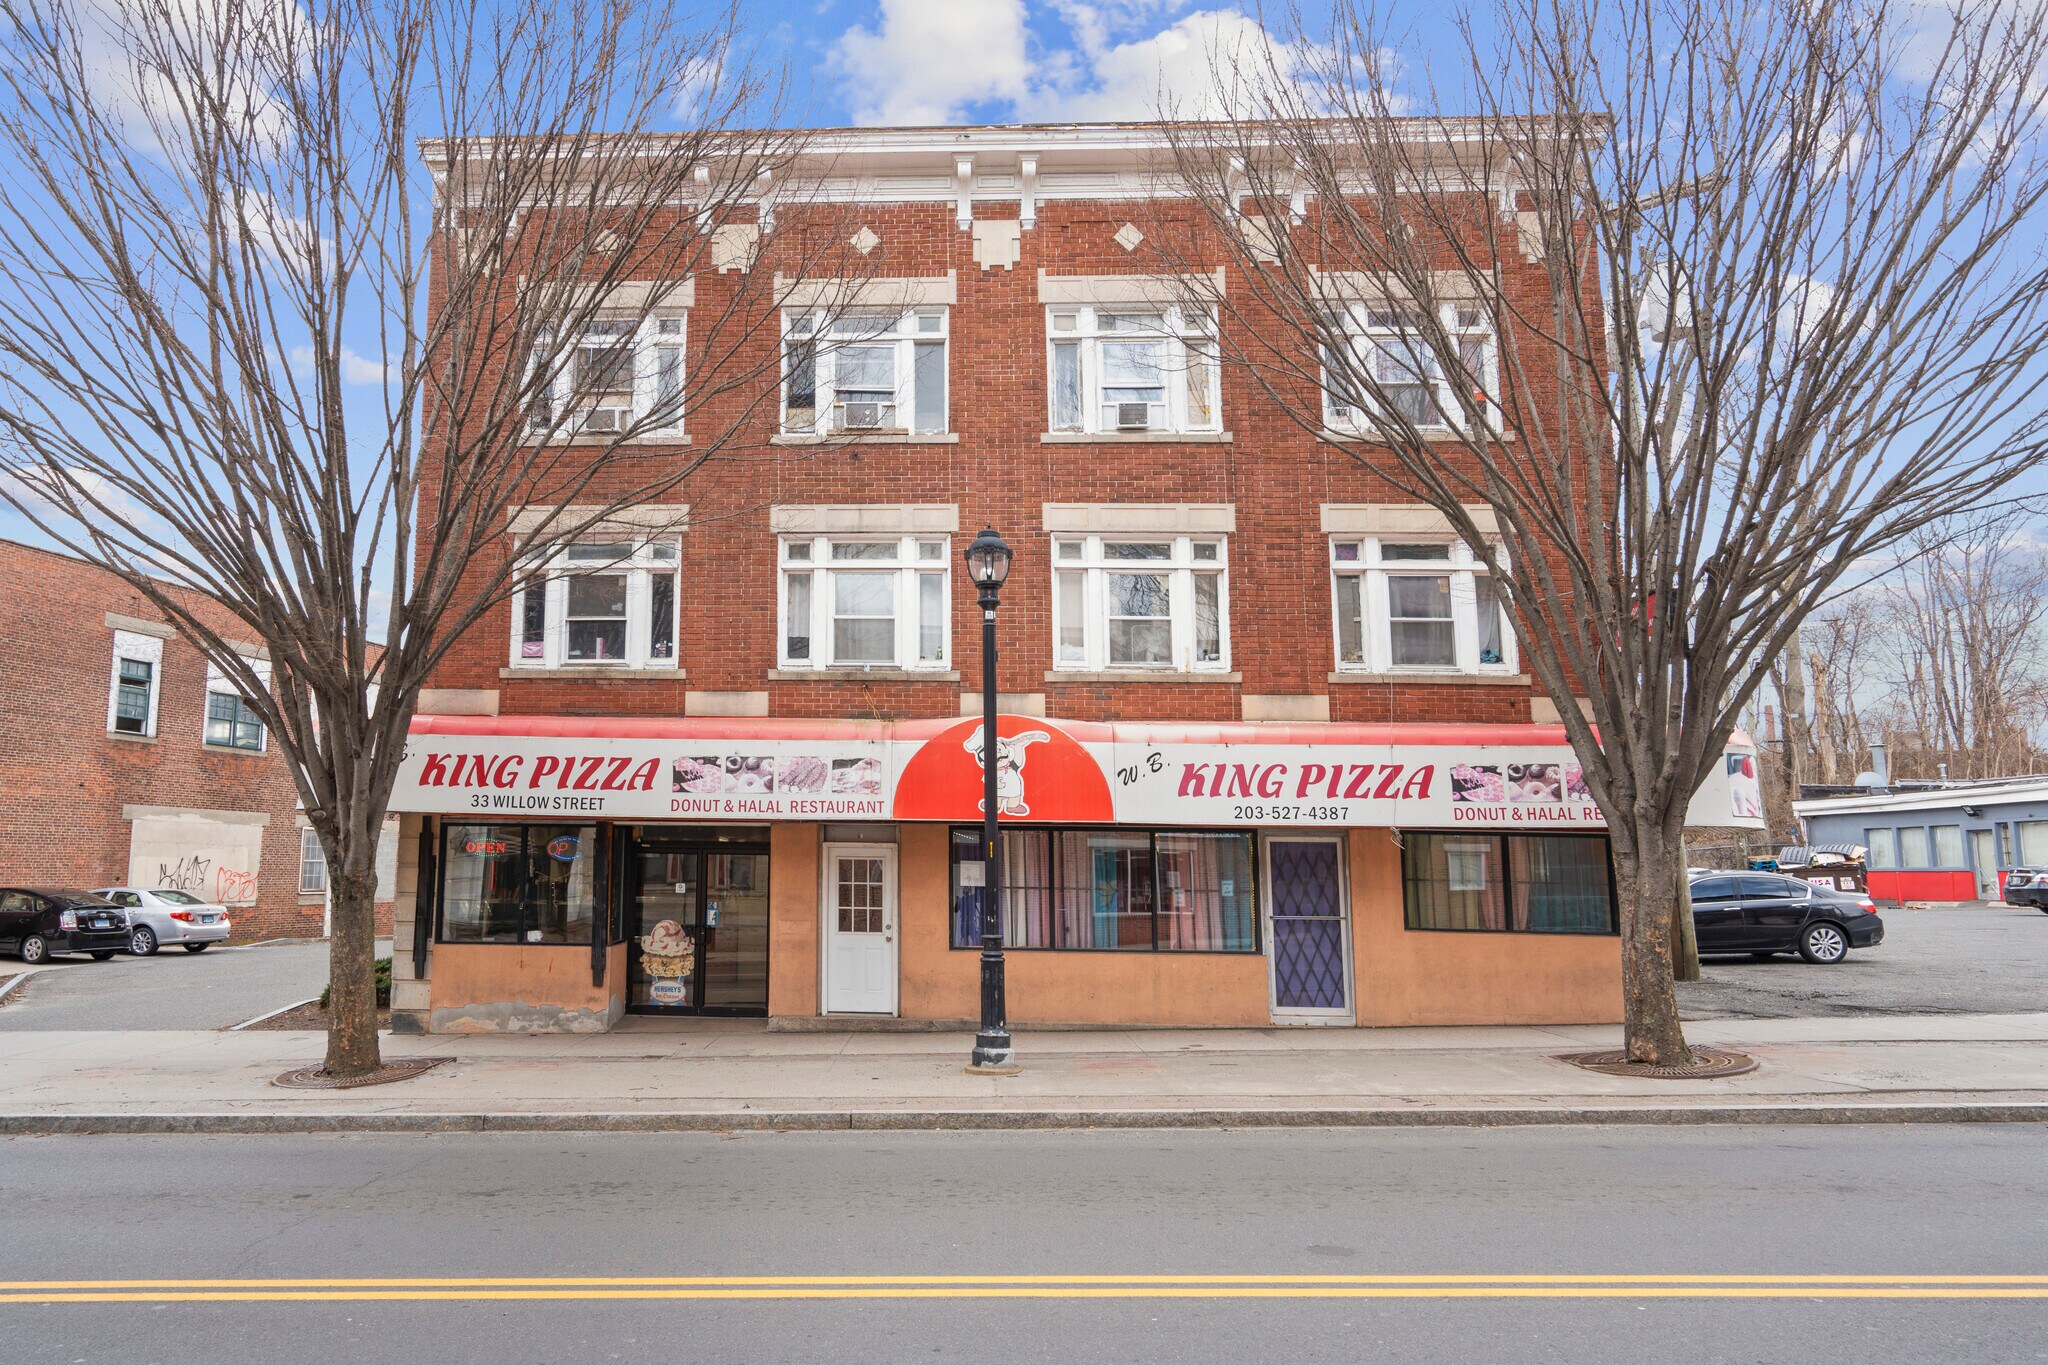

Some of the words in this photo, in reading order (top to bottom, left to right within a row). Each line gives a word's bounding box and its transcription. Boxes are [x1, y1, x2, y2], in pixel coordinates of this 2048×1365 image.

[418, 753, 524, 789] KING
[528, 755, 661, 791] PIZZA
[1177, 762, 1288, 799] KING
[1296, 763, 1435, 800] PIZZA
[471, 794, 490, 808] 33
[493, 795, 550, 809] WILLOW
[552, 796, 605, 810] STREET
[670, 799, 721, 813] DONUT
[723, 800, 735, 813] &
[738, 799, 784, 814] HALAL
[789, 800, 885, 814] RESTAURANT
[1234, 806, 1349, 820] 203-527-4387
[1453, 807, 1507, 821] DONUT
[1511, 807, 1523, 821] &
[1527, 807, 1577, 821] HALAL
[465, 841, 506, 854] OPEN
